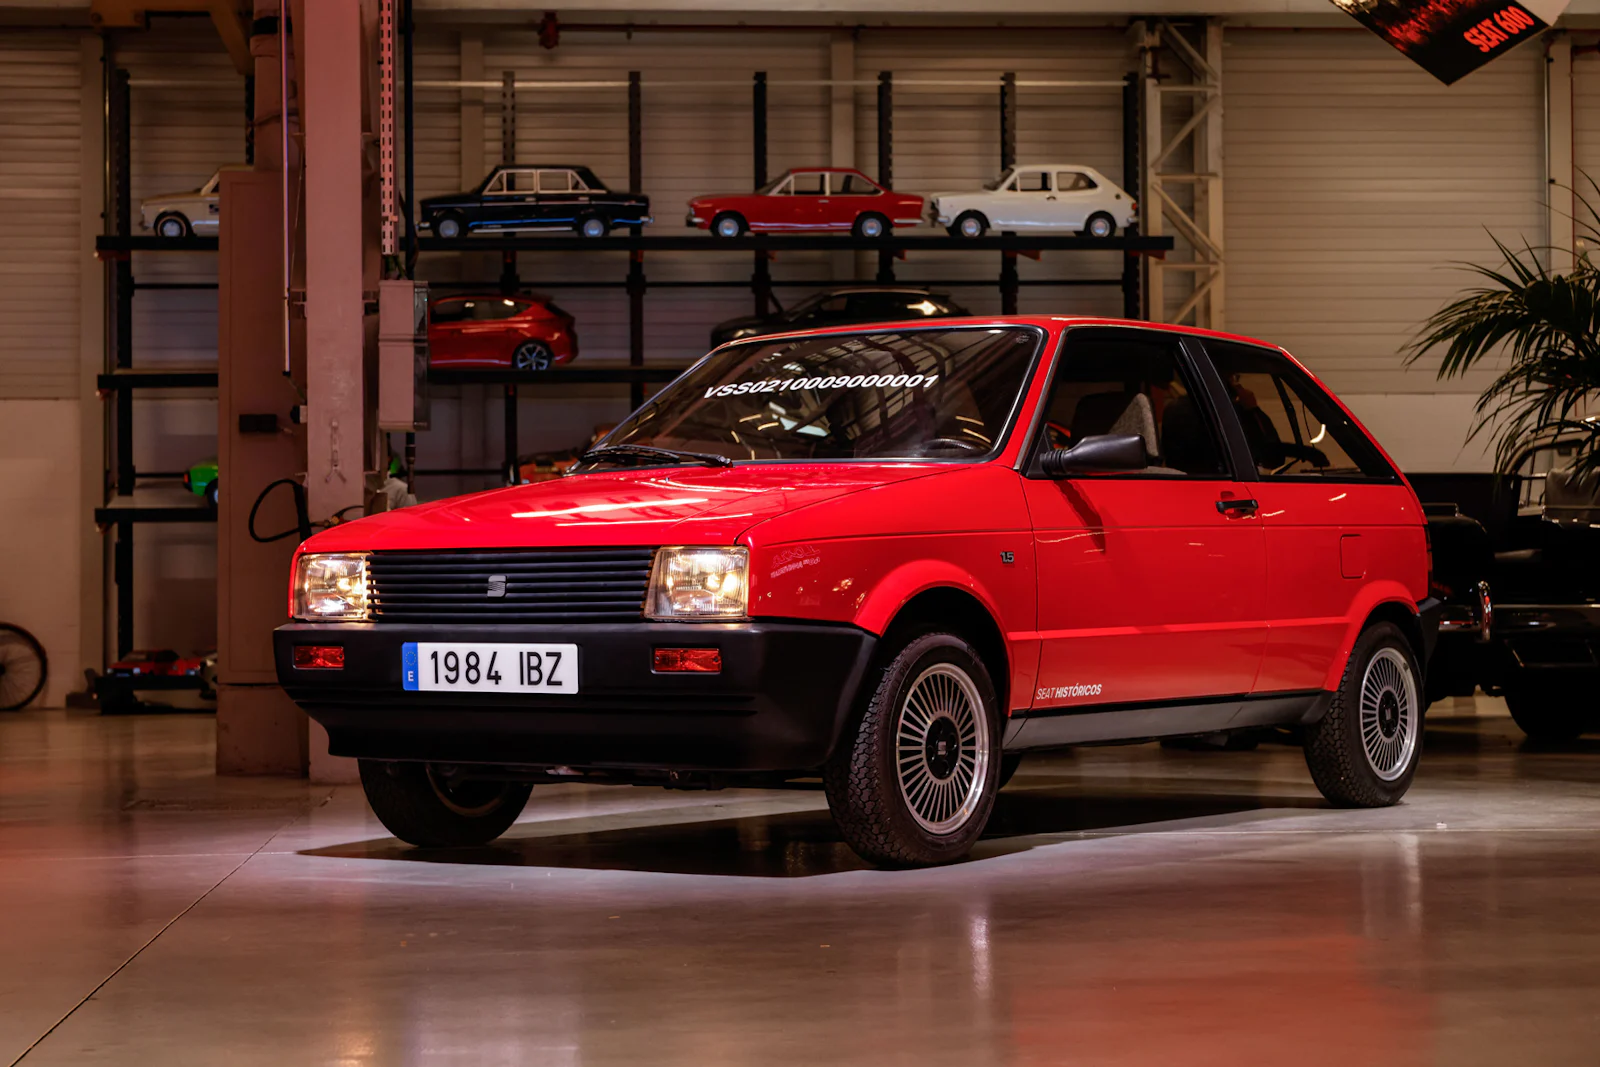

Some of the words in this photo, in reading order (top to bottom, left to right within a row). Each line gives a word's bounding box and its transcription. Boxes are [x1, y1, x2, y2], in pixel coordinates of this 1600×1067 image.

[1463, 18, 1509, 53] SEAT
[1493, 5, 1535, 35] 600
[703, 374, 939, 399] VSS0210009000001
[407, 671, 414, 682] E
[430, 650, 502, 685] 1984
[519, 651, 563, 686] IBZ
[1036, 687, 1056, 700] SEAT
[1054, 682, 1103, 699] HISTÓRICOS
